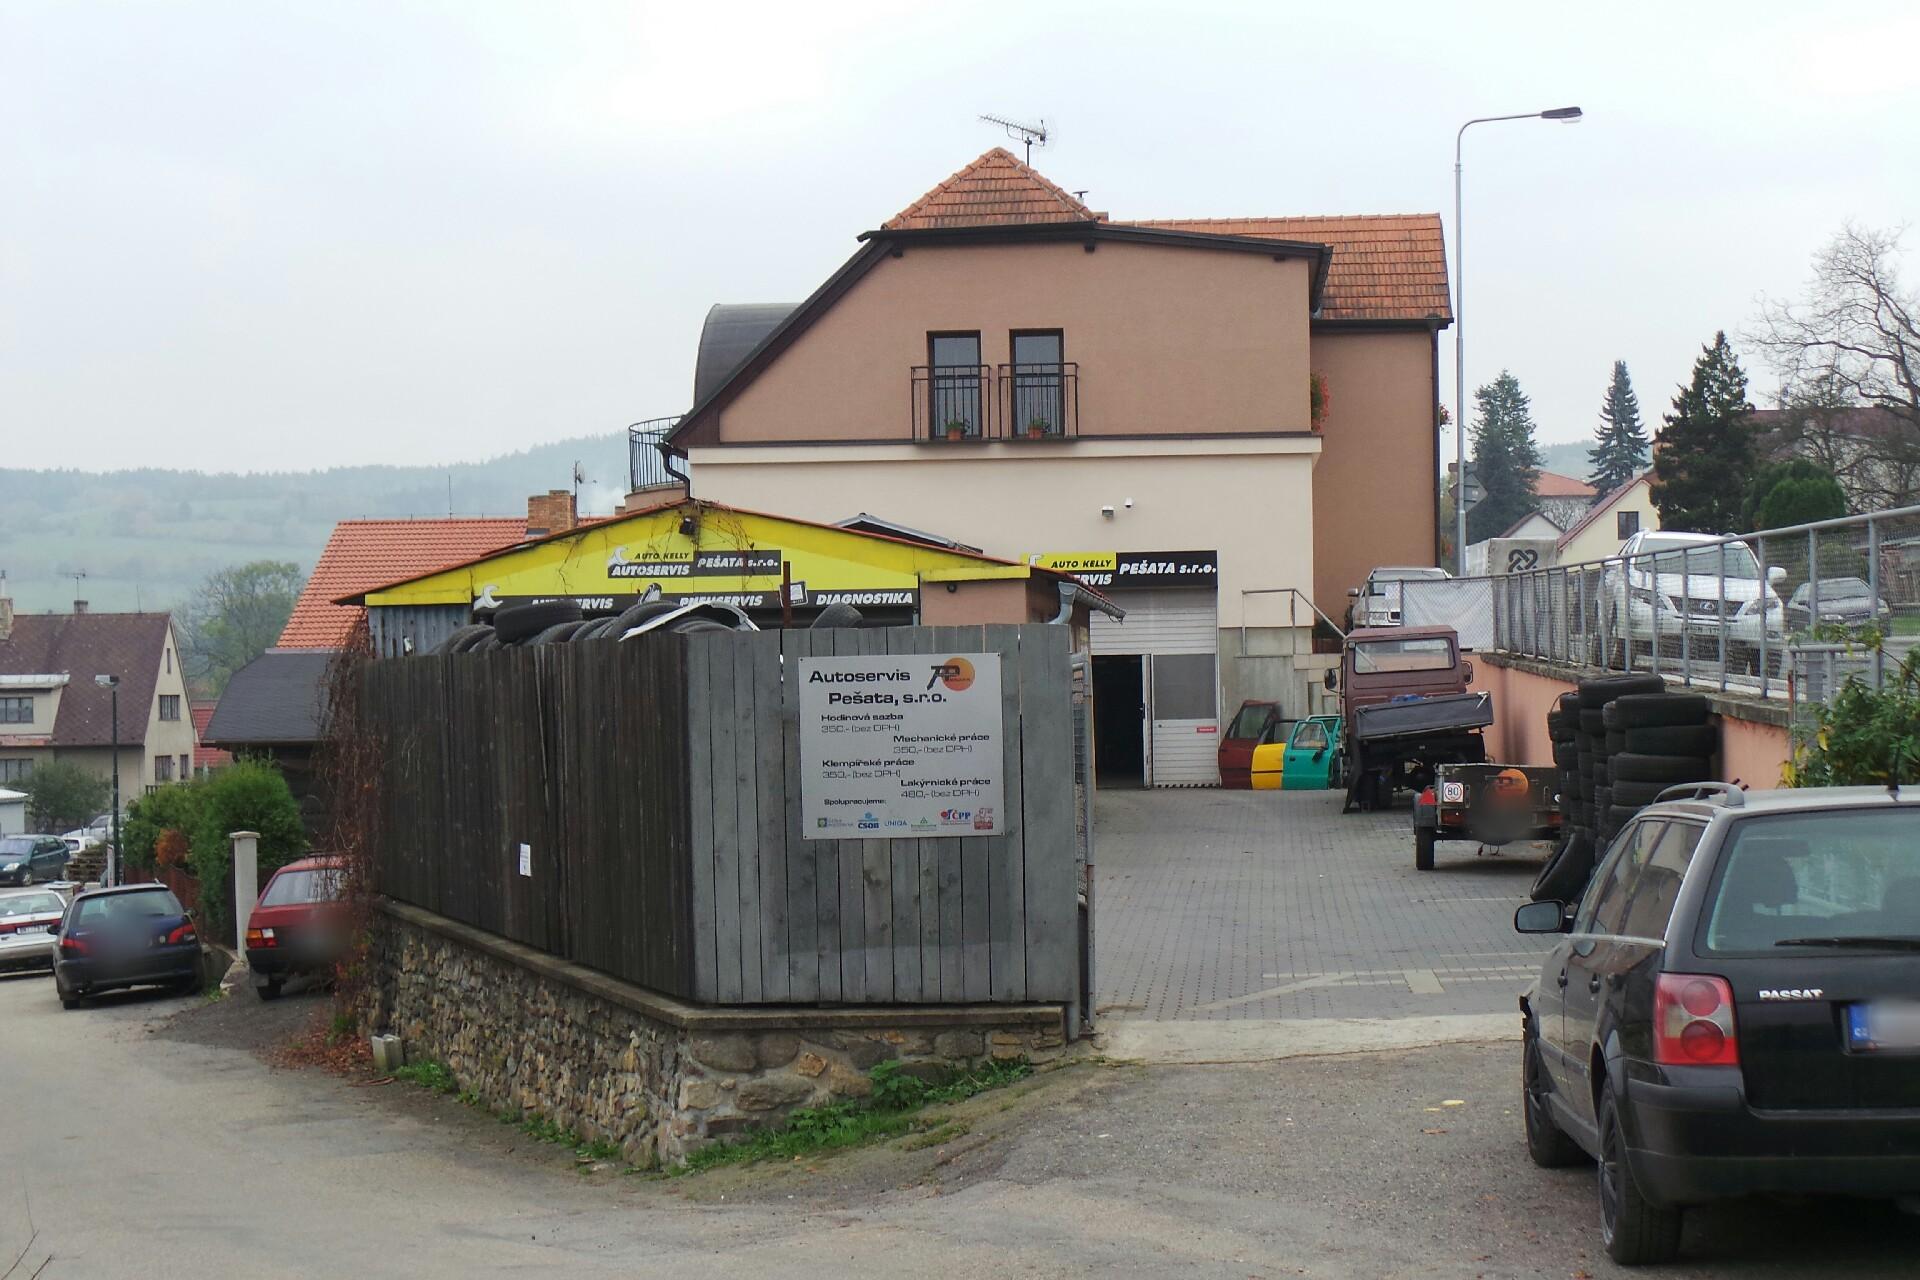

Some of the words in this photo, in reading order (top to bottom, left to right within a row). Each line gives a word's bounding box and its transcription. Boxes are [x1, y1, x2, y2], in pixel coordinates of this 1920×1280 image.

[634, 552, 659, 560] AUTO
[662, 552, 689, 560] KELLY
[697, 555, 744, 568] PEŠATA
[1051, 560, 1078, 569] AUTO
[1082, 559, 1112, 567] KELLY
[611, 564, 690, 576] AUTOSERVIS
[1119, 559, 1175, 575] PEŠATA
[1179, 563, 1217, 574] s.r.o.
[816, 591, 913, 606] DIAGNOSTIKA
[809, 668, 911, 684] Autoservis
[828, 691, 899, 706] Pešata,
[902, 692, 947, 704] s.r.o.
[821, 713, 871, 722] Hodinová
[872, 713, 904, 721] sazba
[873, 724, 900, 732] DPH)
[893, 733, 957, 742] Mechanické
[958, 733, 990, 743] práce
[945, 745, 973, 753] DPH)
[822, 758, 882, 769] Klempířské
[883, 758, 915, 768] práce
[874, 769, 901, 778] DPH)
[900, 778, 958, 788] Lakýrnické
[959, 778, 991, 787] práce
[952, 789, 980, 798] DPH)
[1447, 787, 1459, 796] 80
[1758, 989, 1824, 1001] PASSAT
